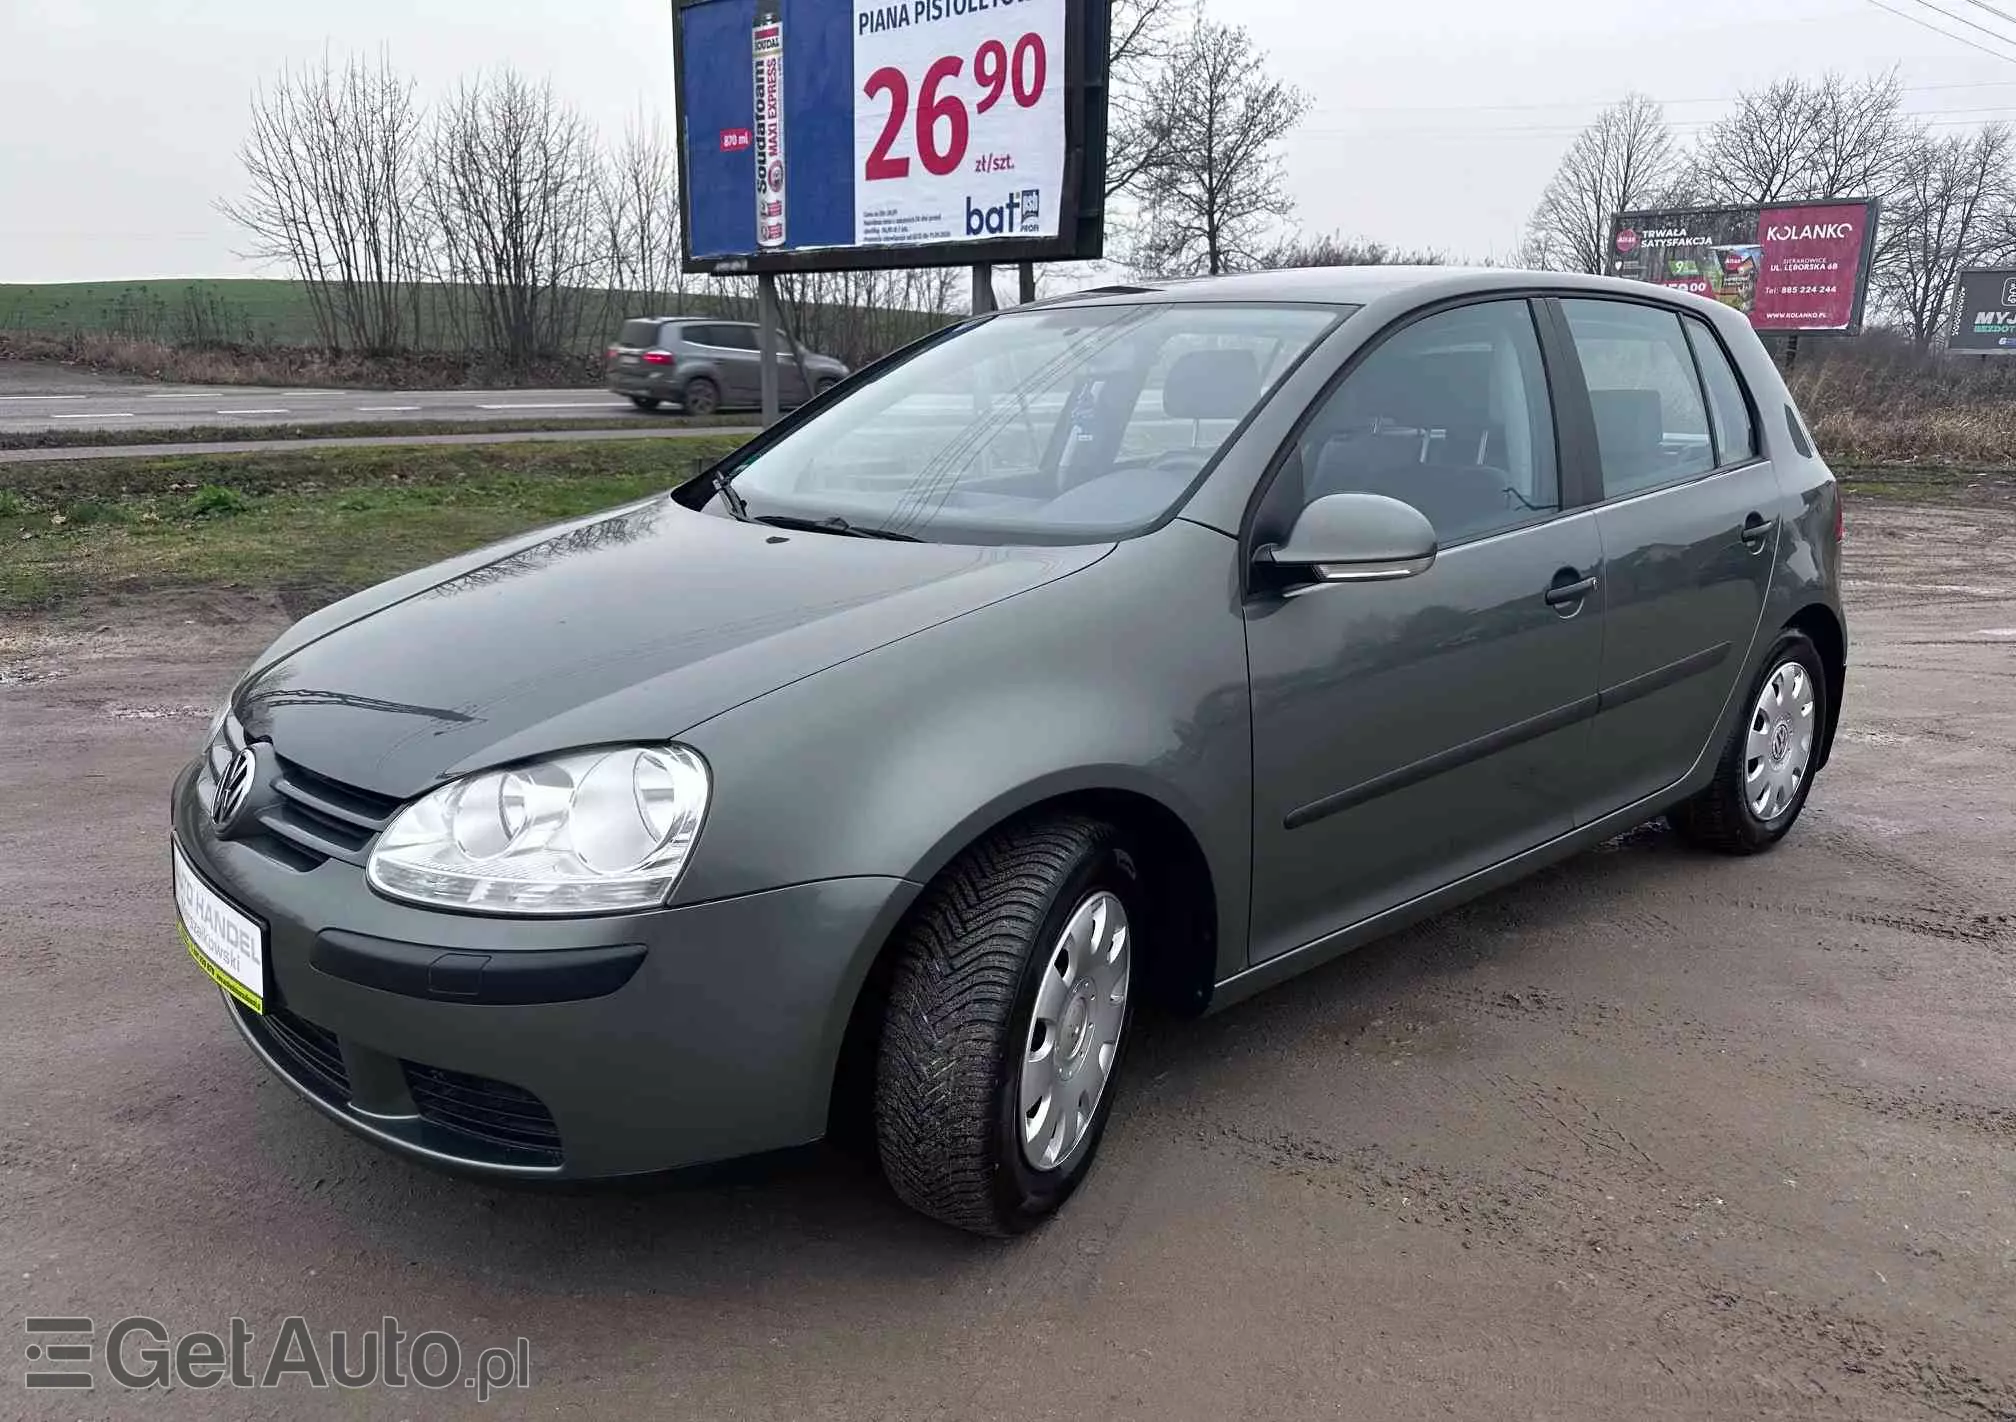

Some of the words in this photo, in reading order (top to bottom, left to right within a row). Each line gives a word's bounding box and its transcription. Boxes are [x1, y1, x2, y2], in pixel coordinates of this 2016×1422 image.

[859, 4, 910, 36] PIANA
[767, 58, 777, 120] EXPRESS
[767, 122, 778, 157] MAXI
[966, 192, 1020, 236] bat
[1641, 237, 1713, 249] SATYSFAKCJA
[1643, 228, 1687, 238] TRWAŁA
[1767, 223, 1853, 241] KOLANKO
[196, 891, 261, 966] HANDEL
